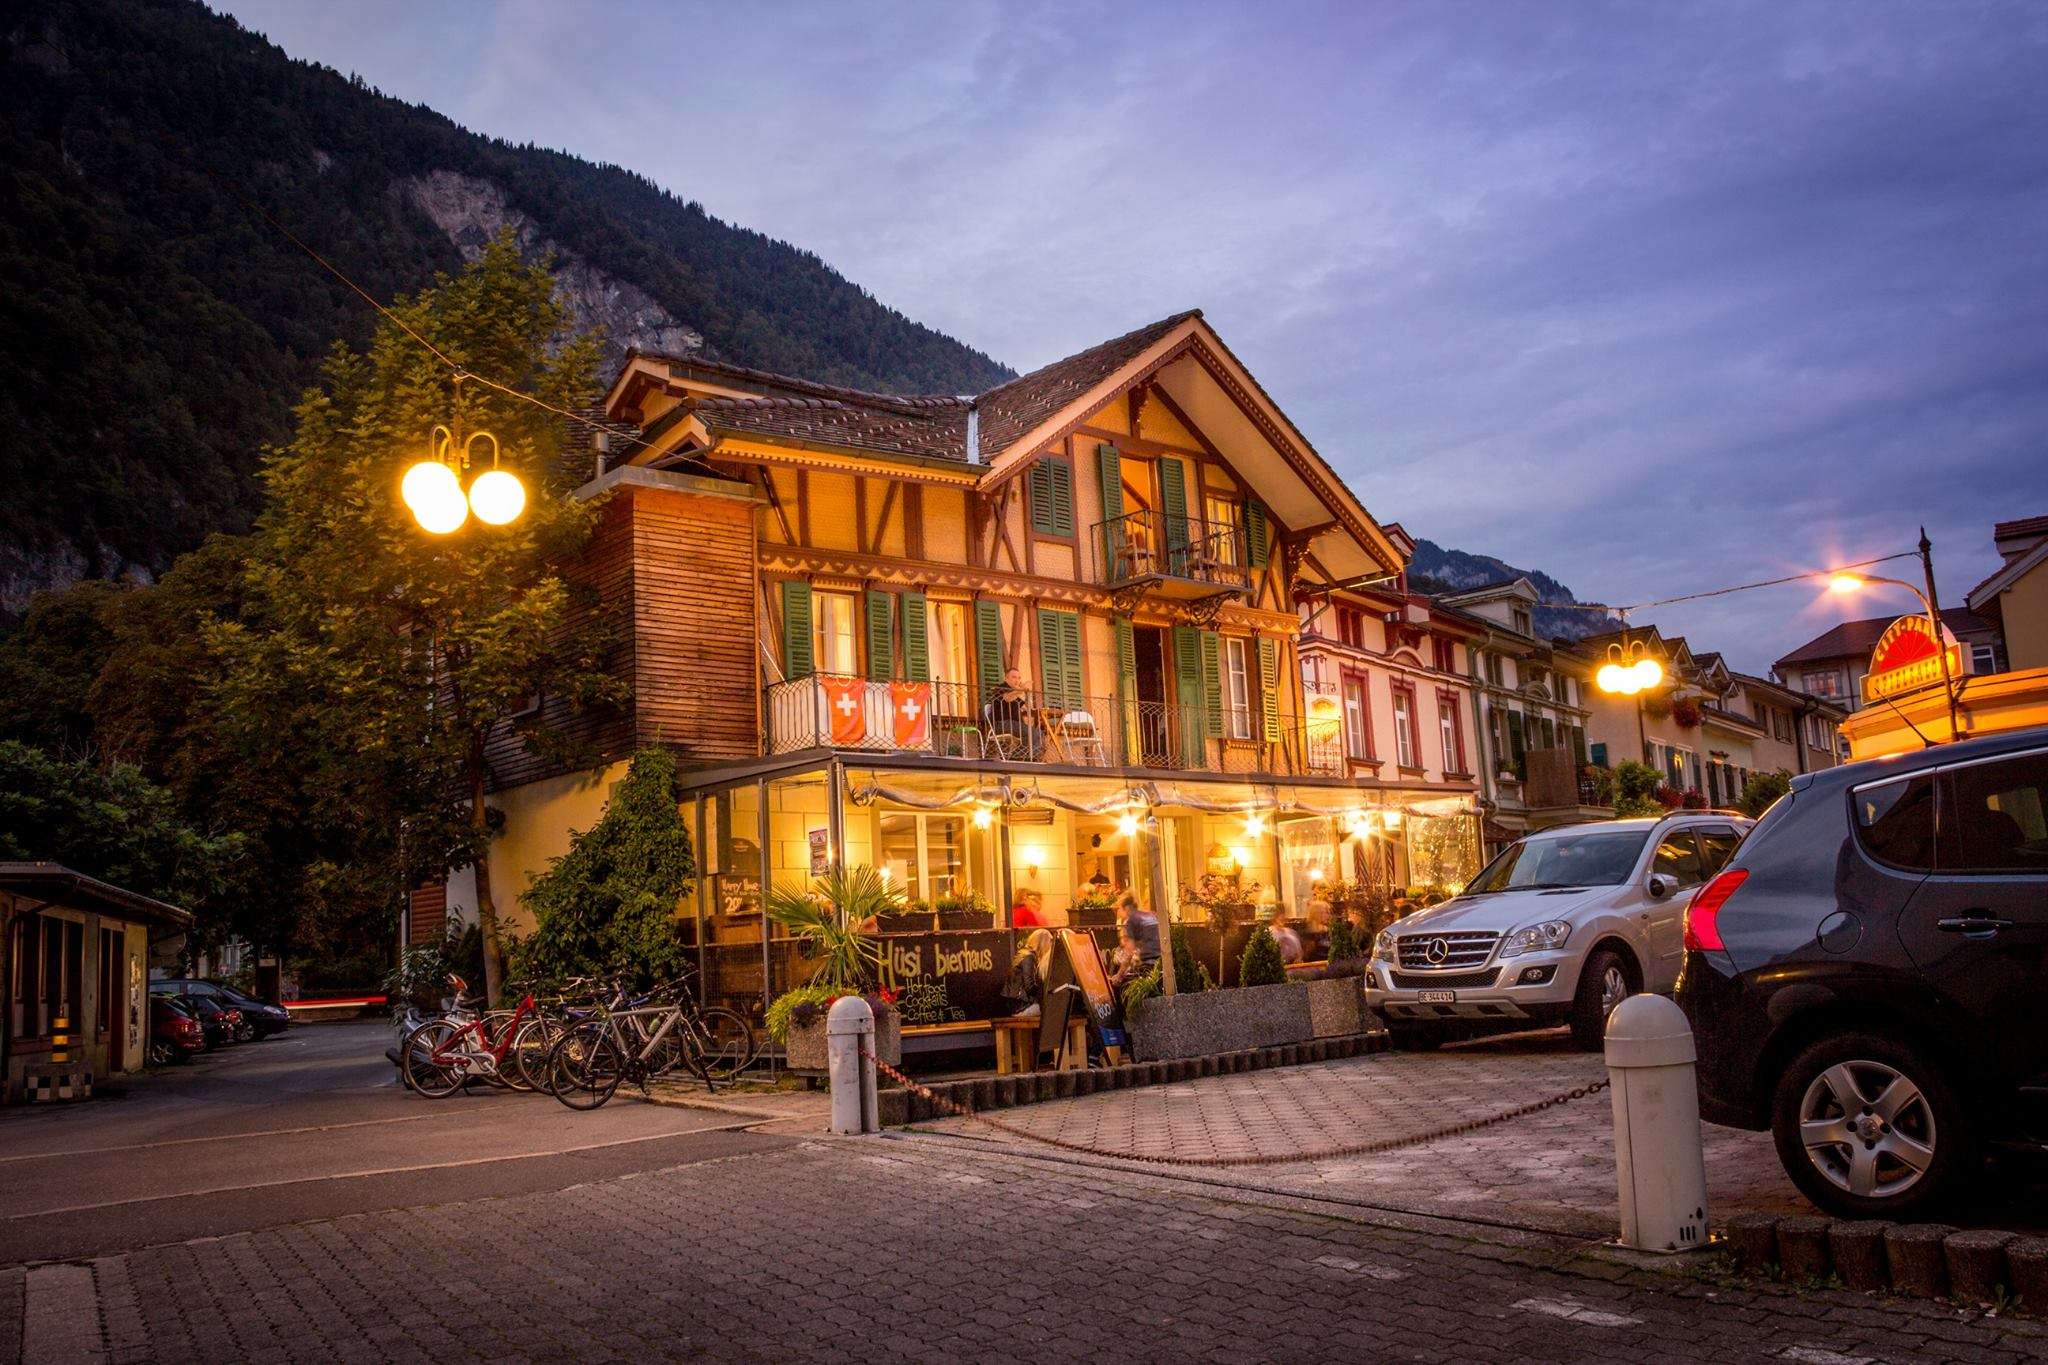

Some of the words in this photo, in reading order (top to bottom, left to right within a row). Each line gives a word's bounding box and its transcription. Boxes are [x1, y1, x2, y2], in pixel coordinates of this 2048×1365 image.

[935, 940, 993, 977] bierhaus
[906, 976, 923, 994] Hot
[923, 973, 947, 994] food
[905, 992, 949, 1008] Cocktails
[907, 1005, 938, 1024] Coffee
